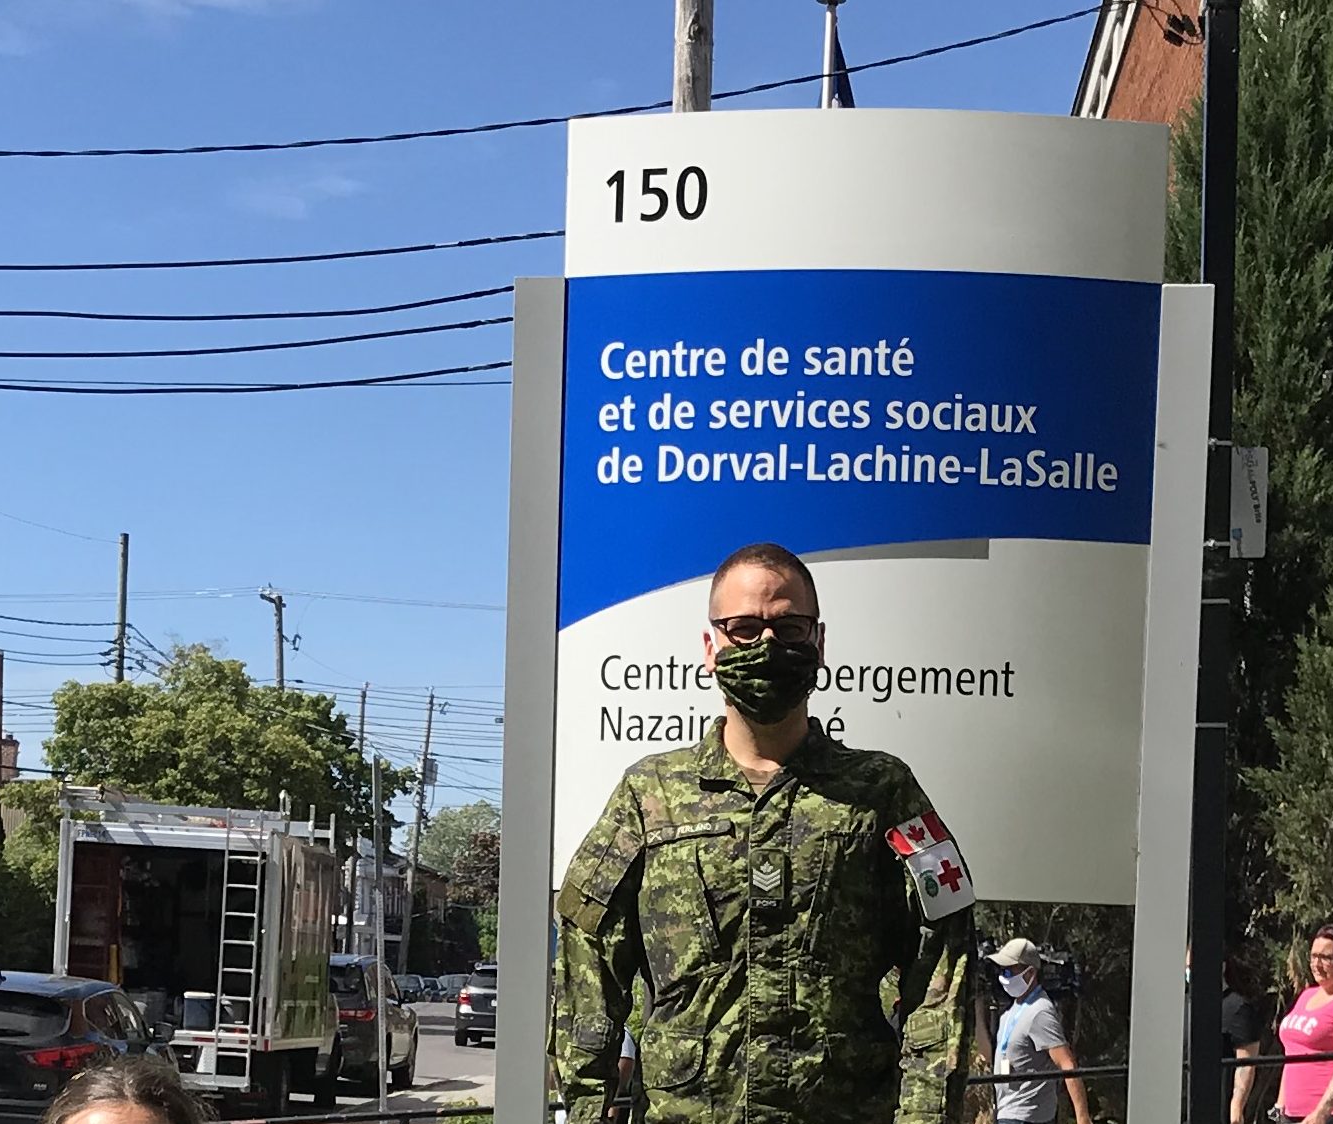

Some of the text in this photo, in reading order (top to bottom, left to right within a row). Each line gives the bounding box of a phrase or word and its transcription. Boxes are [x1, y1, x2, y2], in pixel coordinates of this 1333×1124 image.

[606, 165, 708, 223] 150
[600, 337, 914, 380] Centre de santé
[598, 390, 1037, 434] et de services sociaux
[597, 443, 1118, 491] de Dorval-Lachine-LaSalle
[601, 654, 713, 691] Centre
[600, 706, 712, 743] Nazair
